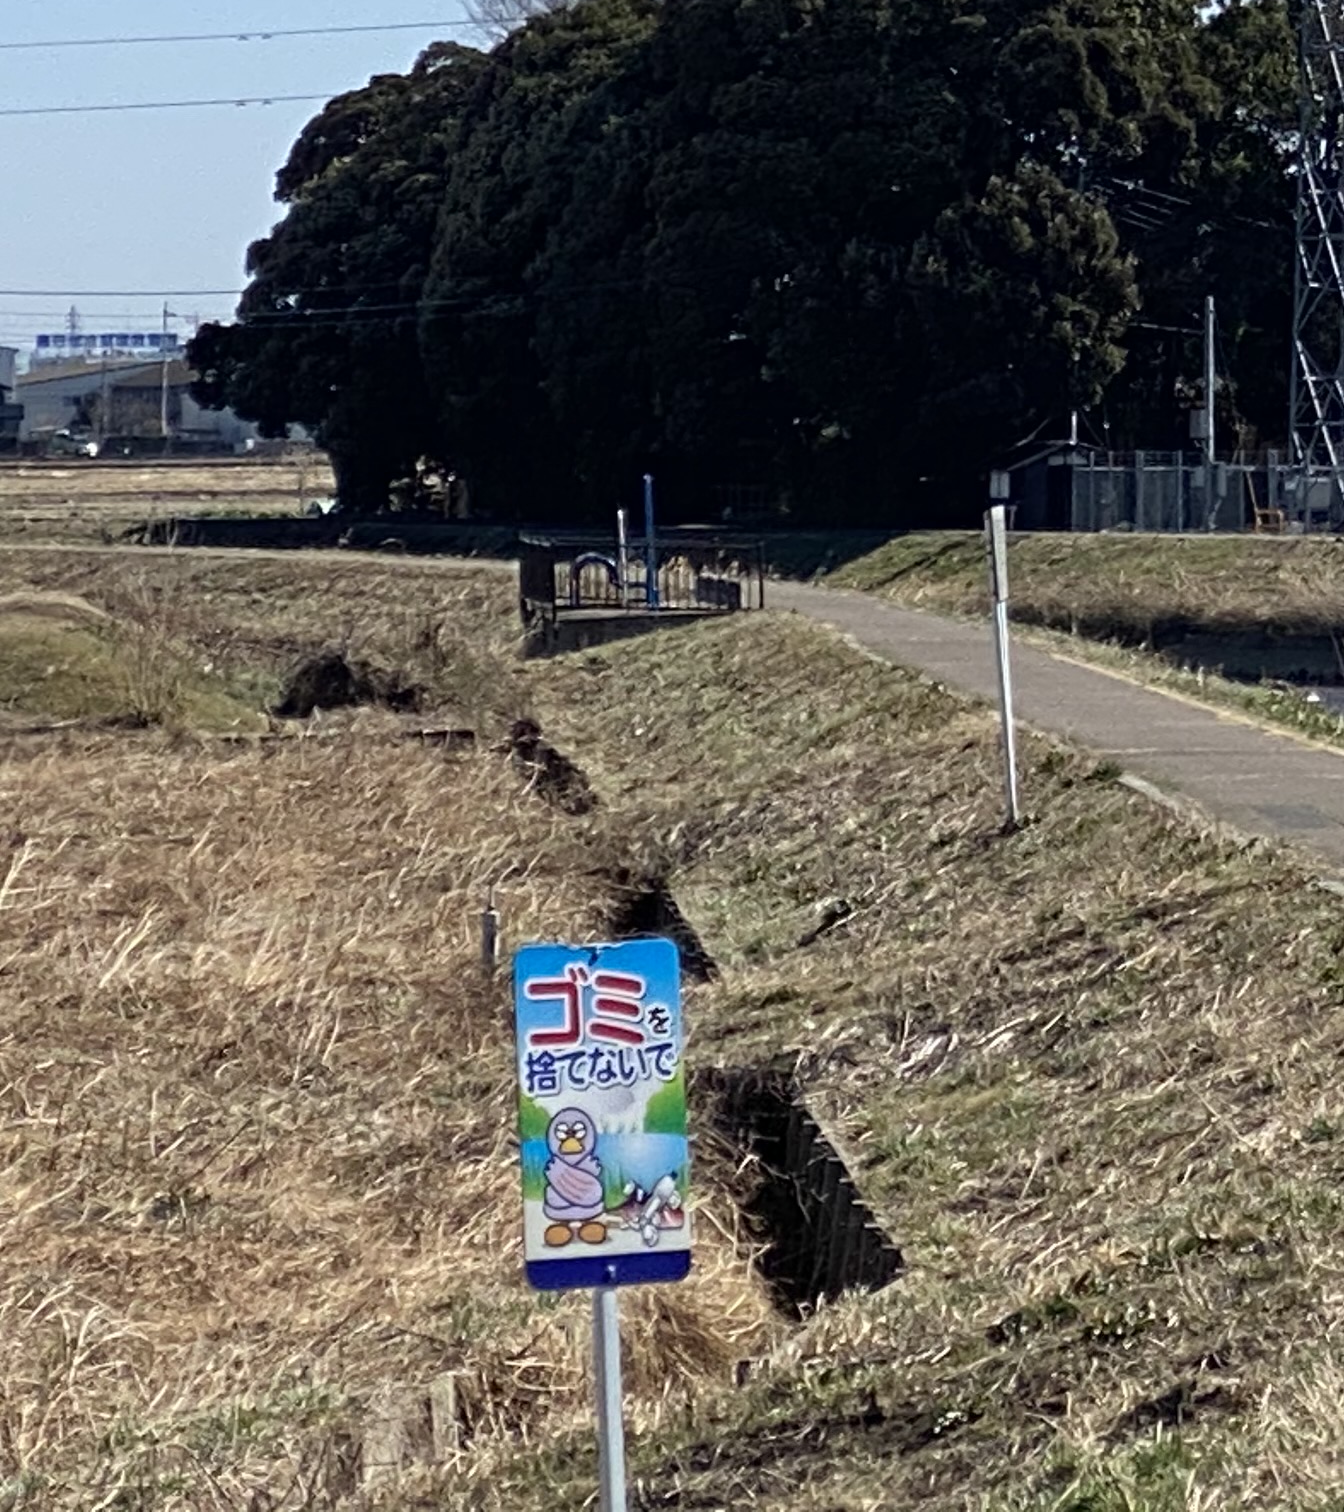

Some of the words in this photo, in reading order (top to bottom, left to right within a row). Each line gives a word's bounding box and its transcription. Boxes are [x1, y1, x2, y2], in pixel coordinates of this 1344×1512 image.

[526, 966, 671, 1045] ゴミを
[526, 1043, 676, 1093] 捨てないで
